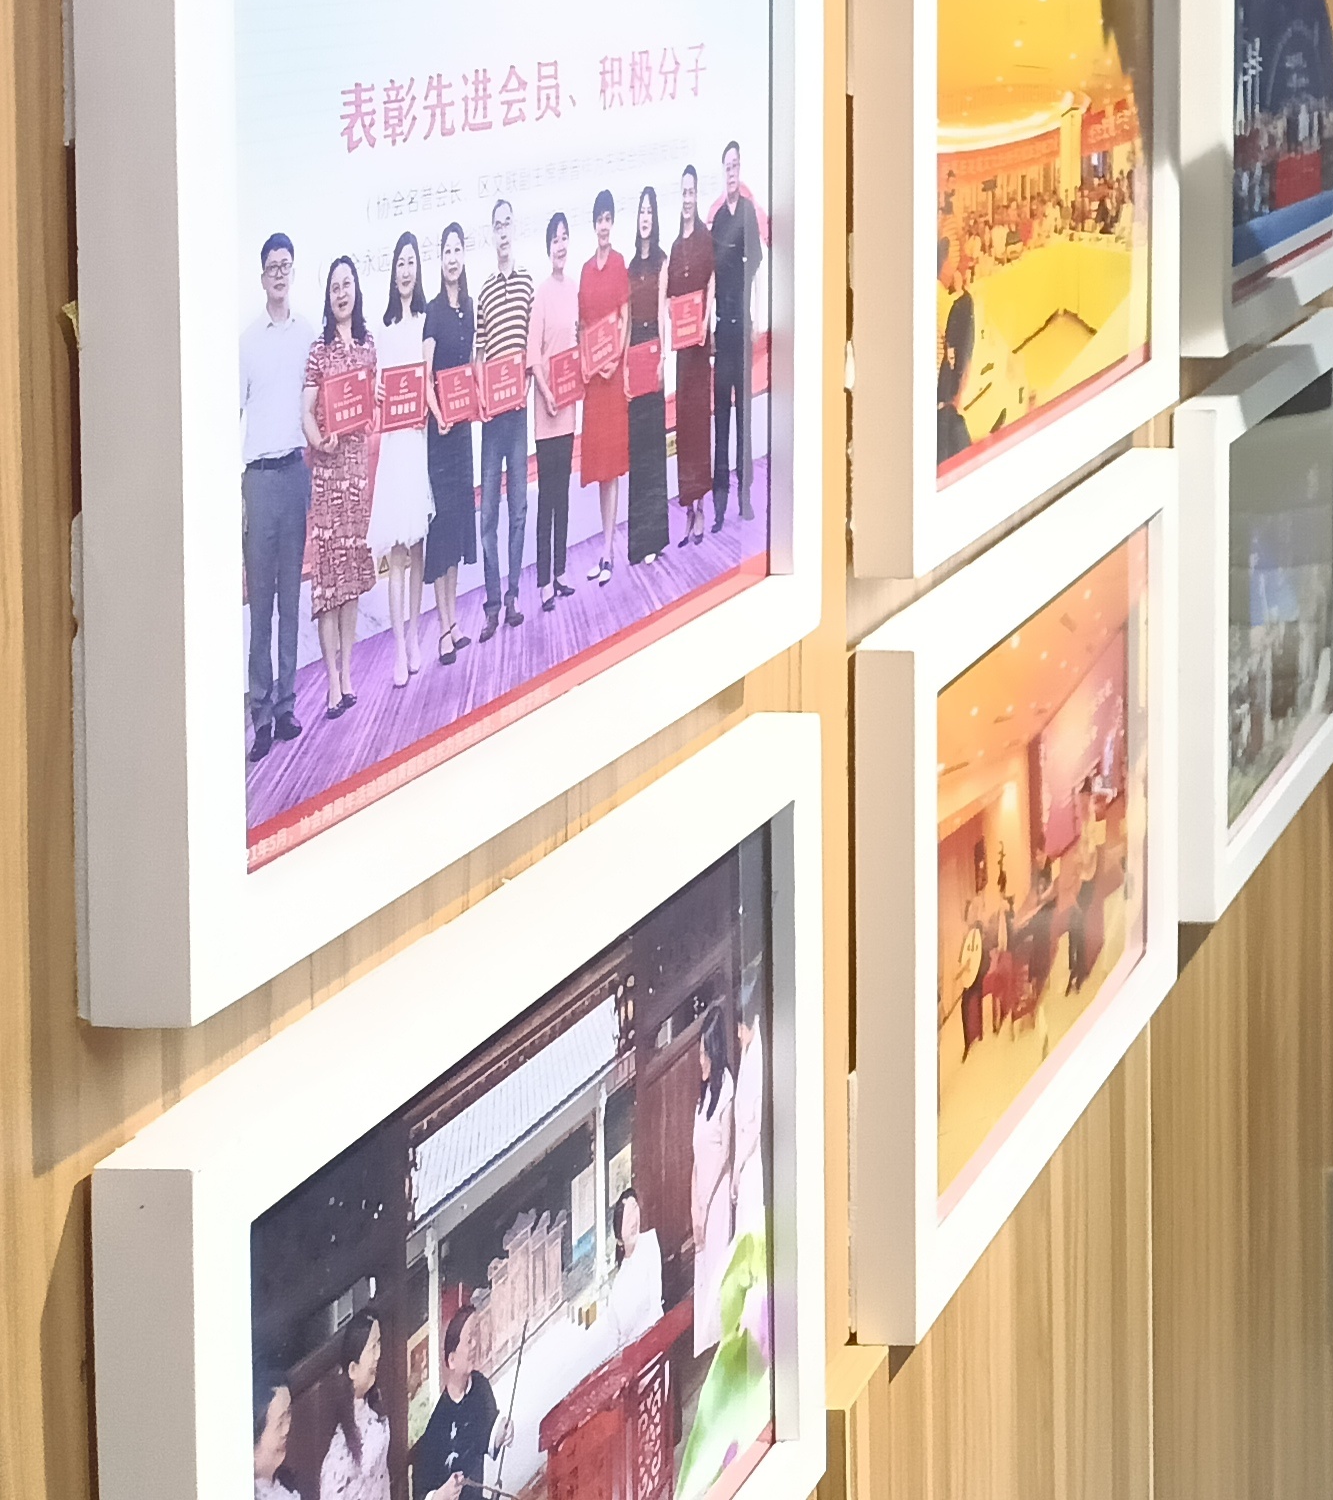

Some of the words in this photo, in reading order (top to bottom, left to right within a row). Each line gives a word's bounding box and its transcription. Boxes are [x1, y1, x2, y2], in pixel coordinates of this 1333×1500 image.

[340, 43, 708, 154] 表彰先进会员、积极分子
